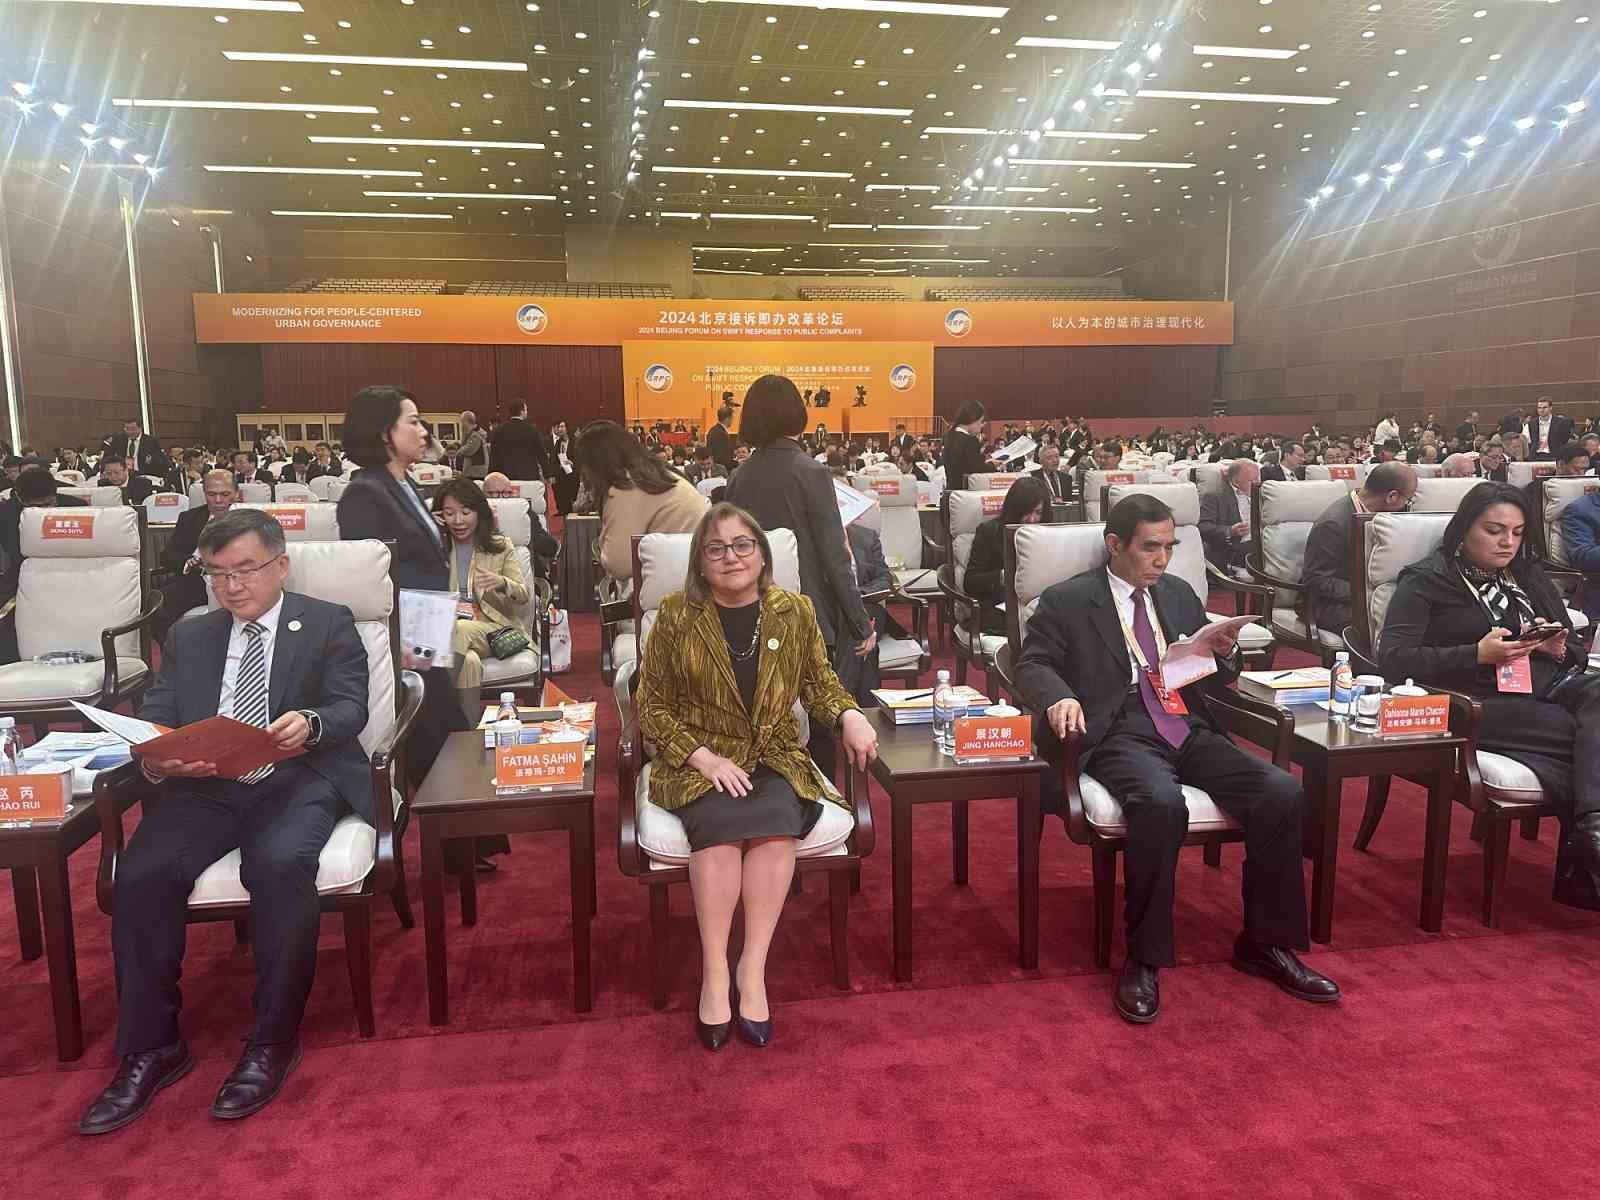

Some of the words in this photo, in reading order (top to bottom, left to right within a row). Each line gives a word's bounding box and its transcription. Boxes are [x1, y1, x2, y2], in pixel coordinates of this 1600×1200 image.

[232, 307, 301, 317] MODERNIZING
[304, 307, 324, 317] FOR
[327, 307, 422, 317] PEOPLE-CENTERED
[275, 319, 311, 328] URBAN
[313, 319, 382, 328] GOVERNANCE
[1051, 315, 1206, 329] 以人为本的城市治理现代化
[656, 327, 683, 335] BEIJING
[685, 327, 710, 335] FORUM
[723, 327, 743, 336] SWIFT
[745, 327, 781, 336] RESPONSE
[794, 327, 818, 336] PUBLIC
[820, 327, 863, 337] COMPLAINTS
[962, 742, 982, 750] JING
[983, 740, 1025, 749] HANCHAO
[502, 754, 541, 768] FATMA
[0, 802, 20, 810] HAO
[22, 801, 41, 809] RUI
